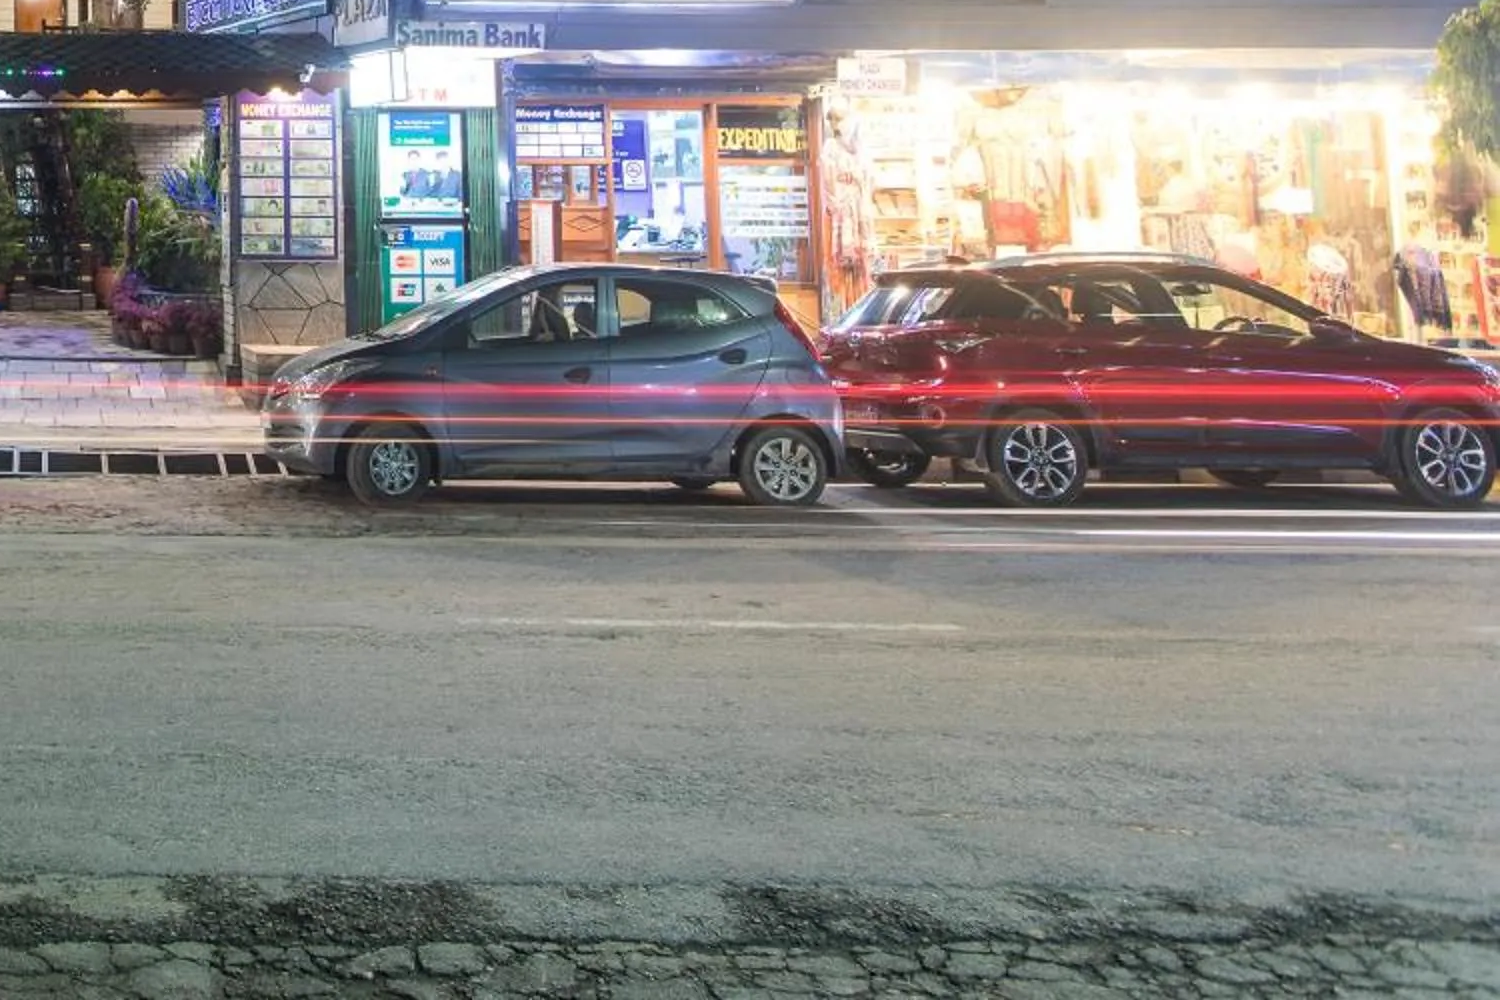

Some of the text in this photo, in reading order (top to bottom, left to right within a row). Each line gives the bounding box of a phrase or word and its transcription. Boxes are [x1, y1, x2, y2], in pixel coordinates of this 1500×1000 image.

[397, 21, 542, 49] Sanima Bank
[241, 103, 277, 118] MONEY
[429, 257, 452, 266] VISA
